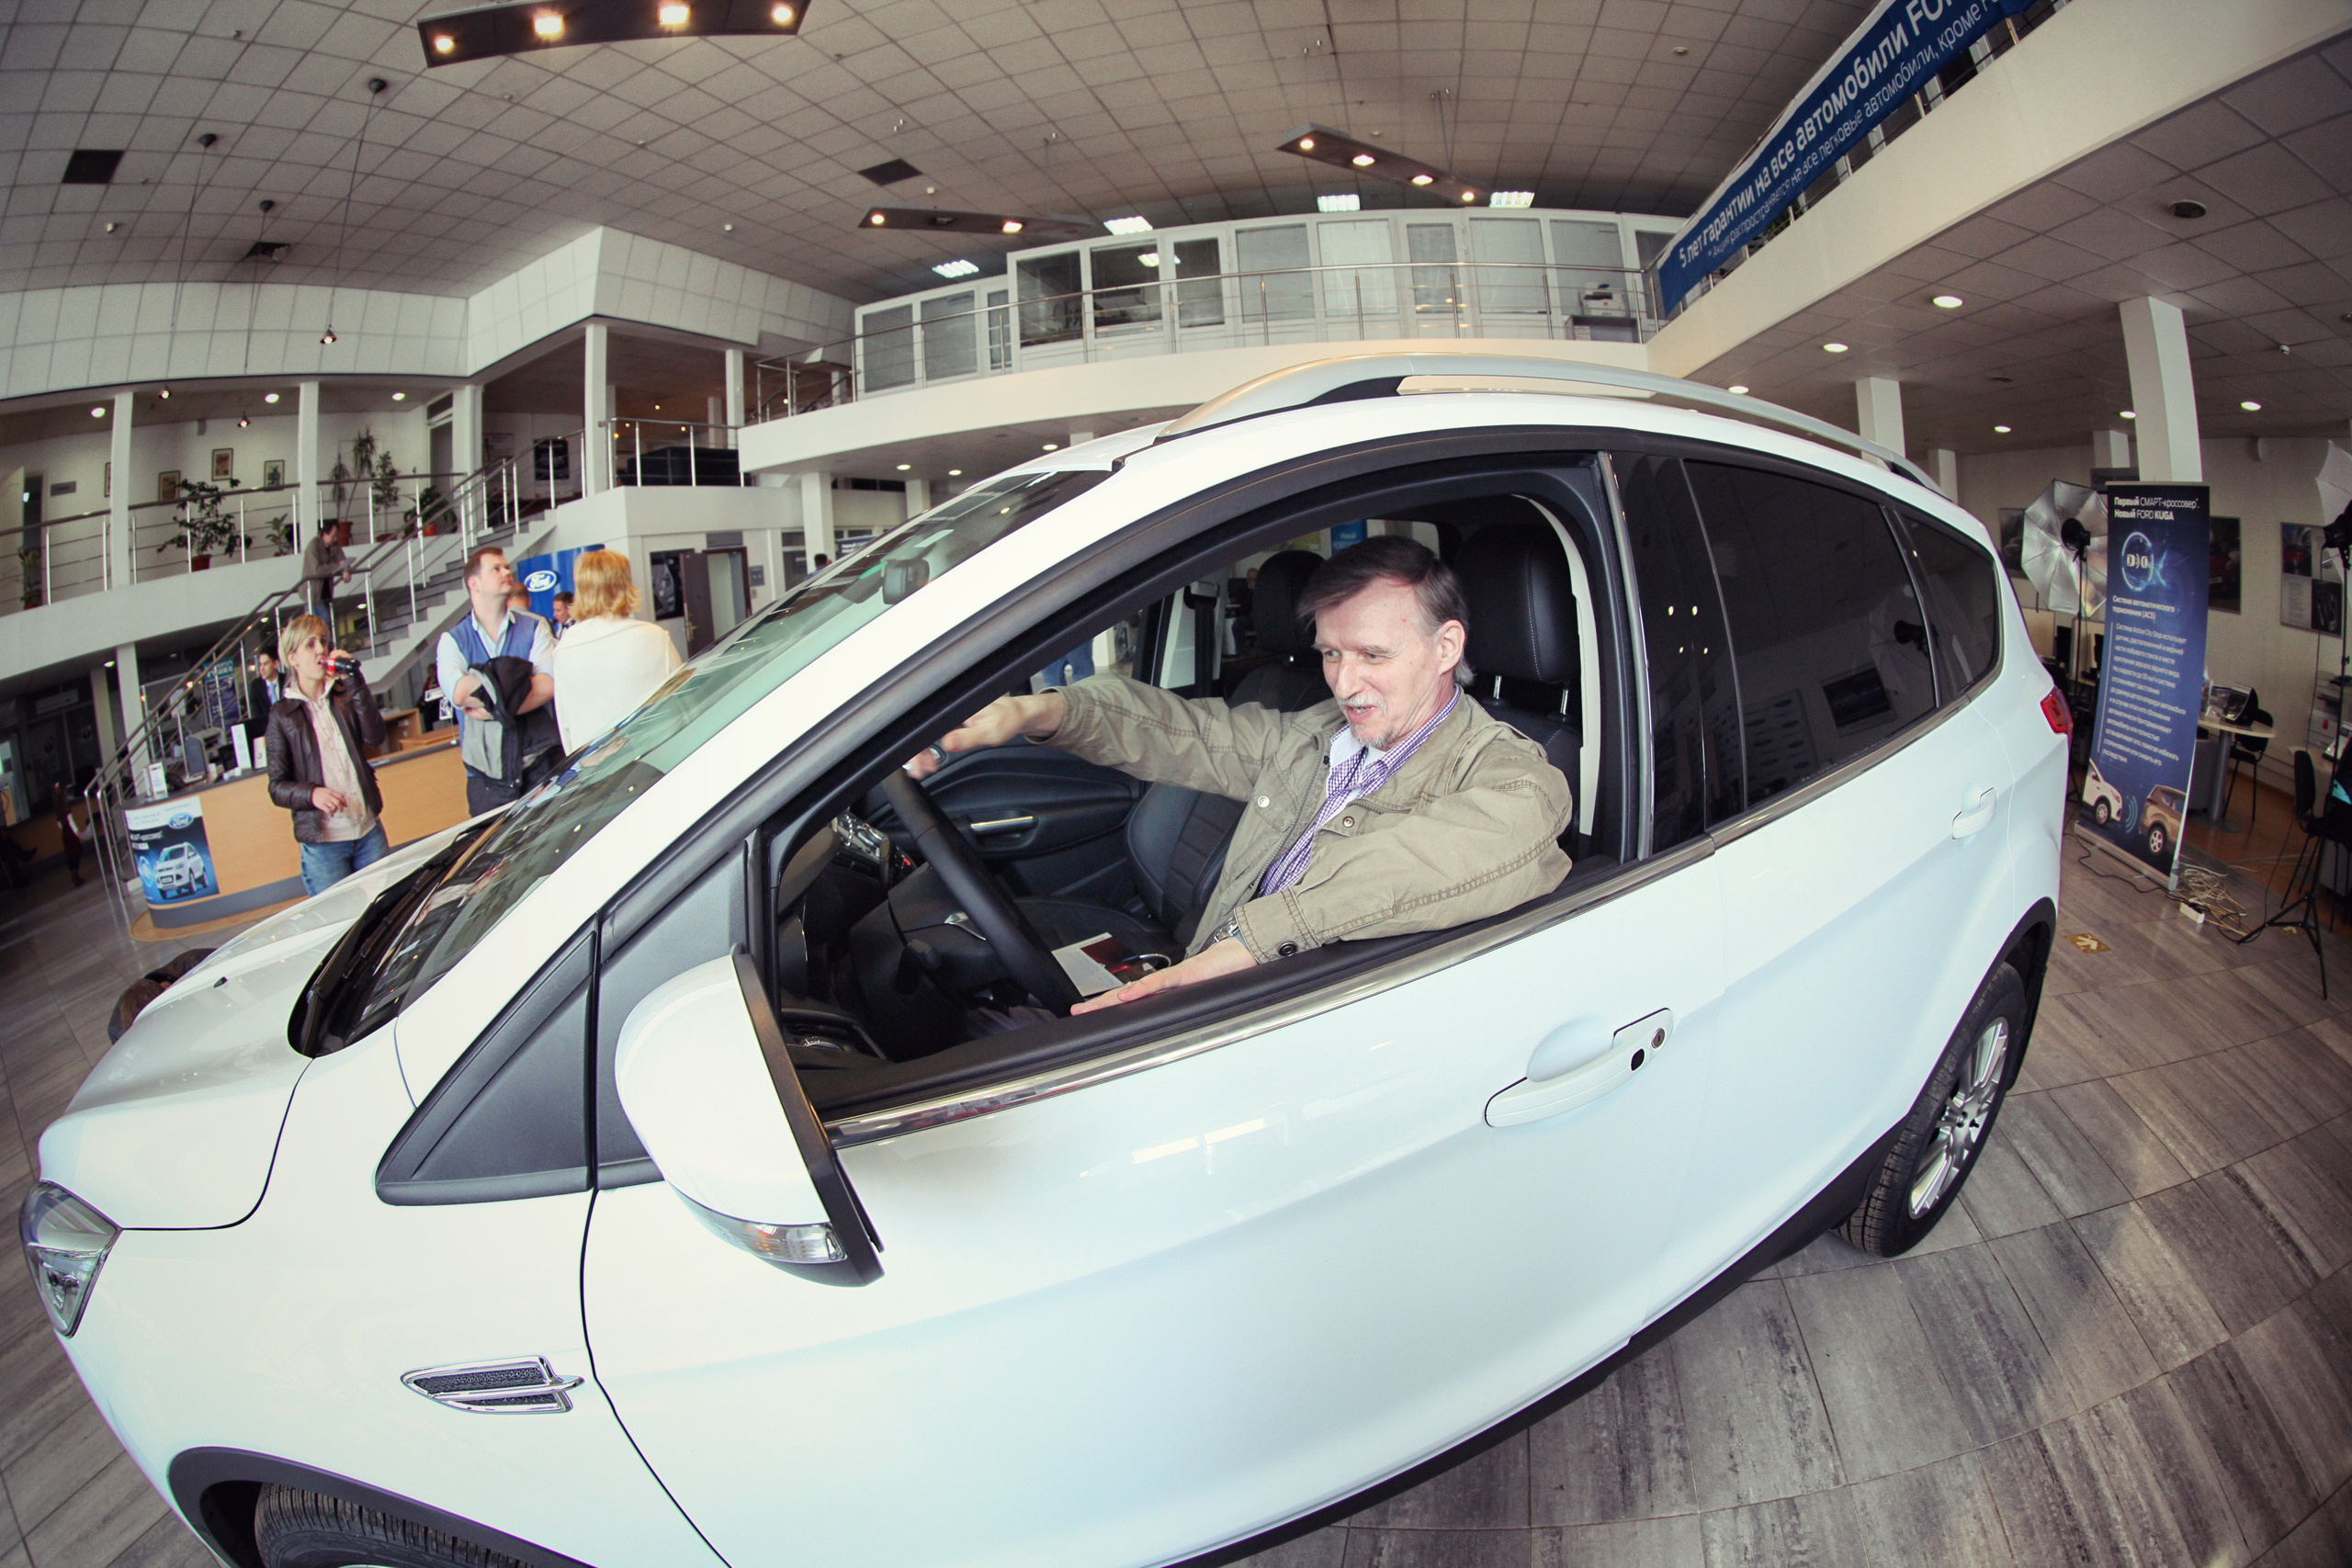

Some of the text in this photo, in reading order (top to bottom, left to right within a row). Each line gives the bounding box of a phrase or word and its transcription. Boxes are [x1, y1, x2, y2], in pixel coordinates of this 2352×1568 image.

[1729, 178, 1792, 244] распространяется
[1791, 167, 1803, 186] на
[1803, 152, 1819, 175] все
[1819, 109, 1863, 161] легковые
[1864, 44, 1940, 118] автомобили,
[1938, 4, 1982, 51] кроме
[1679, 0, 1952, 267] 5 лет гарантии на все автомобили FO
[2115, 496, 2139, 507] Первый
[2115, 508, 2174, 520] Новый FORD KUGA
[528, 573, 551, 589] Ford
[170, 814, 191, 828] Ford
